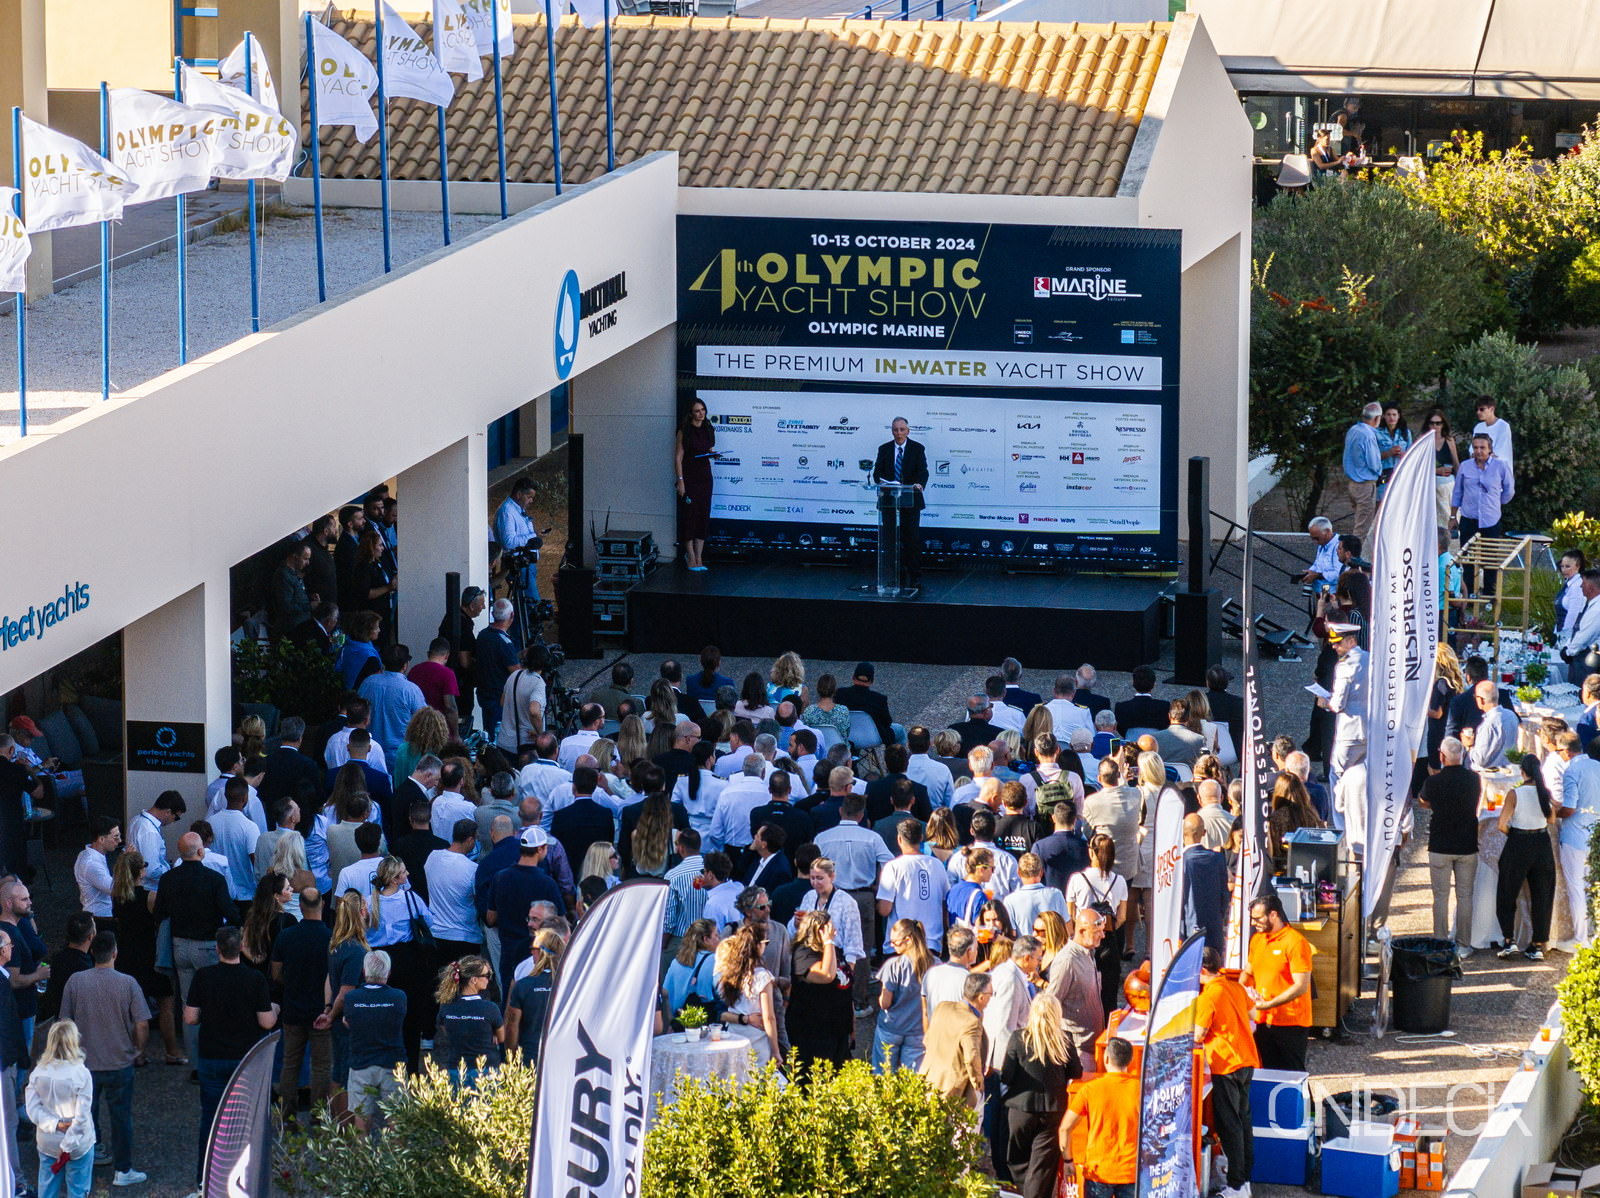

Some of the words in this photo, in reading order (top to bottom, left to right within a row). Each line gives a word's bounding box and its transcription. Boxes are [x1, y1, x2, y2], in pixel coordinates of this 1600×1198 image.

[811, 234, 850, 247] 10-13
[854, 235, 931, 250] OCTOBER
[936, 237, 976, 251] 2024
[756, 251, 981, 290] OLYMPIC
[1051, 275, 1127, 297] MARINE
[735, 285, 857, 316] YACHT
[868, 288, 986, 320] SHOW
[588, 309, 618, 338] YACHTING
[808, 321, 878, 336] OLYMPIC
[882, 323, 945, 338] MARINE
[714, 353, 756, 370] THE
[765, 354, 864, 374] PREMIUM
[874, 358, 987, 377] IN-WATER
[996, 361, 1068, 380] YACHT
[1076, 364, 1145, 382] SHOW
[37, 581, 90, 640] yachts
[1389, 602, 1398, 634] ΣΑΣ
[1403, 547, 1422, 683] NESPRESSO
[1388, 642, 1397, 712] FREDDO
[565, 1018, 613, 1198] URY
